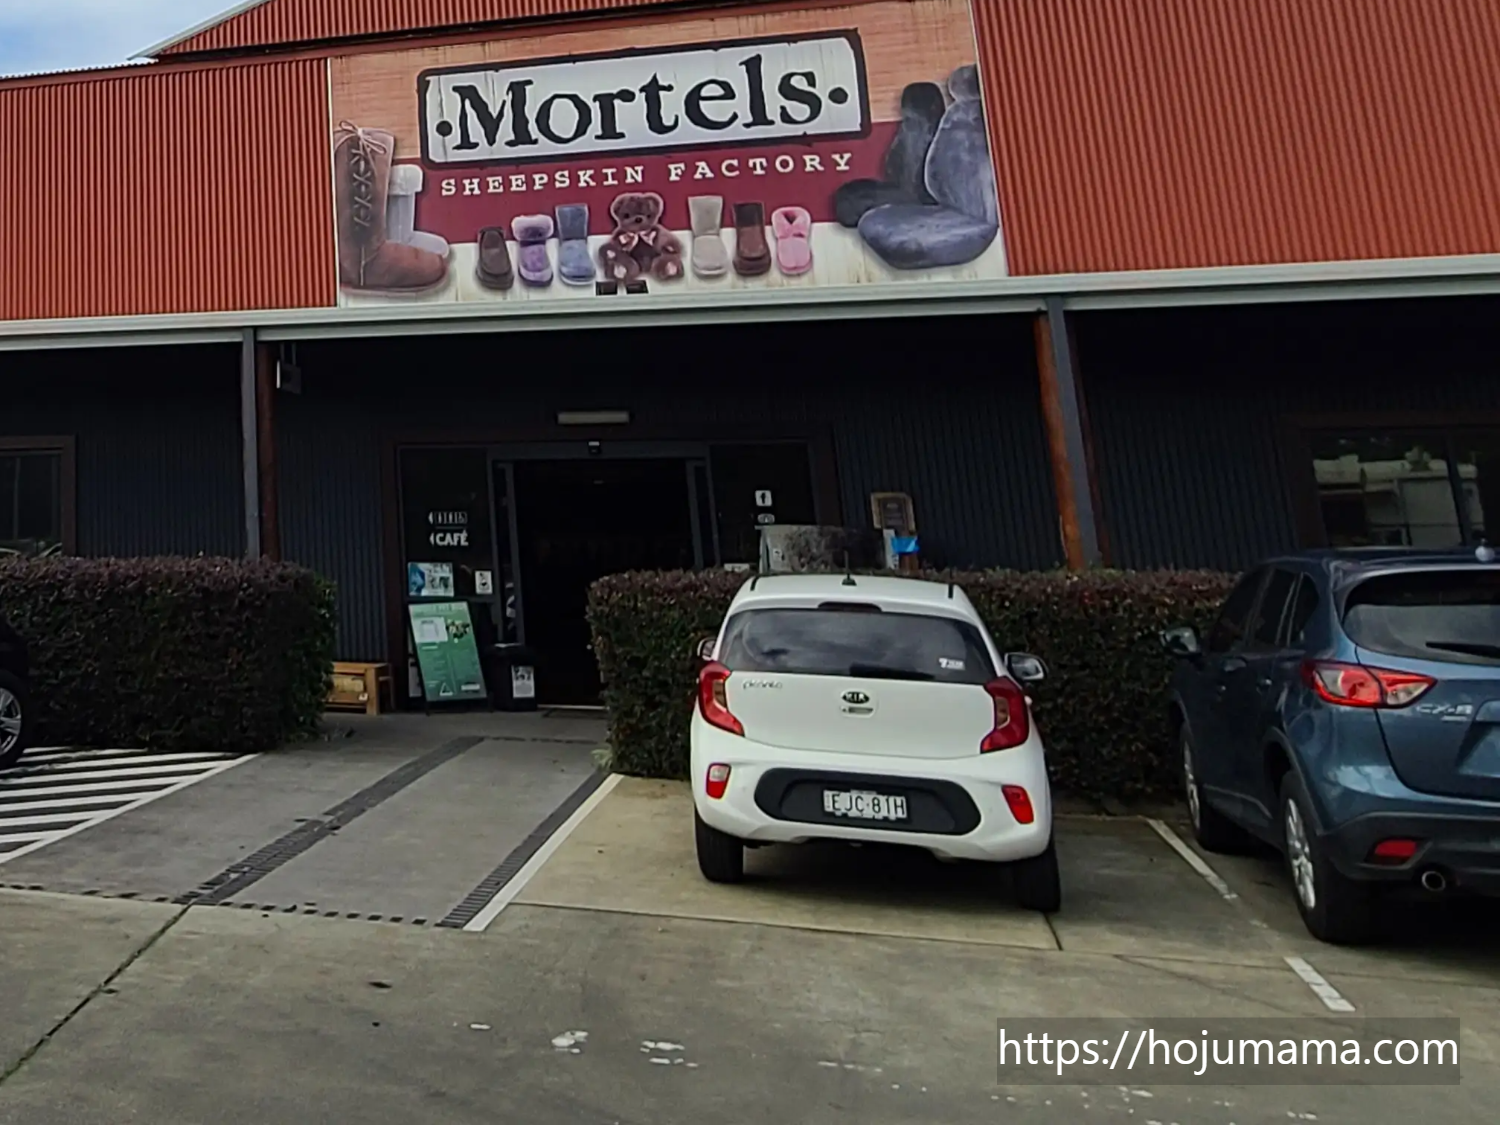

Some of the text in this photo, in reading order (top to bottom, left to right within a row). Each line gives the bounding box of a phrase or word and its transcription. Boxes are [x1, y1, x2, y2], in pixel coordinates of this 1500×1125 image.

[441, 152, 853, 196] SHEEPSKIN FACTORY
[435, 528, 470, 548] CAFÉ
